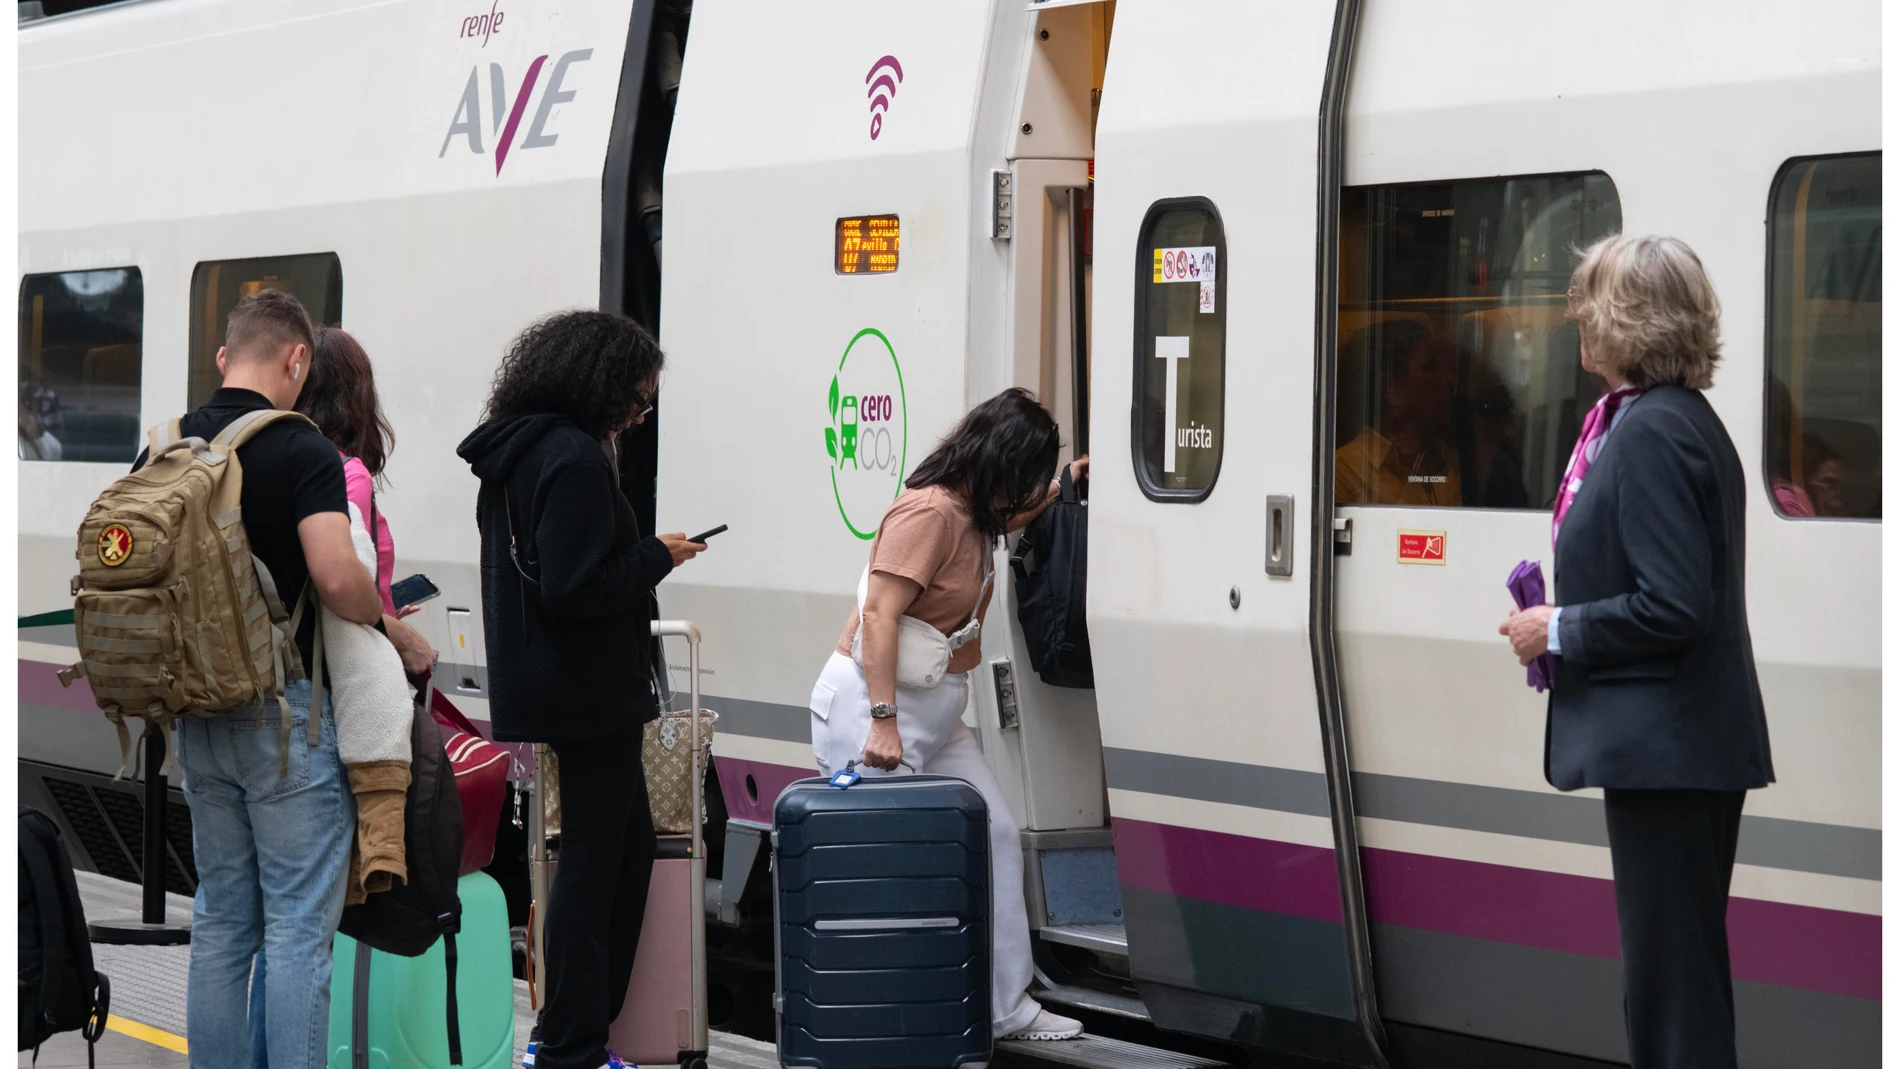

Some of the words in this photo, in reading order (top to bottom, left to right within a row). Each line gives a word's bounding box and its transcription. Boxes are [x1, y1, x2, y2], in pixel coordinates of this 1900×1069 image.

[460, 0, 504, 48] renfe
[438, 48, 595, 179] AVE
[860, 395, 892, 422] cero
[1154, 336, 1212, 473] Turista
